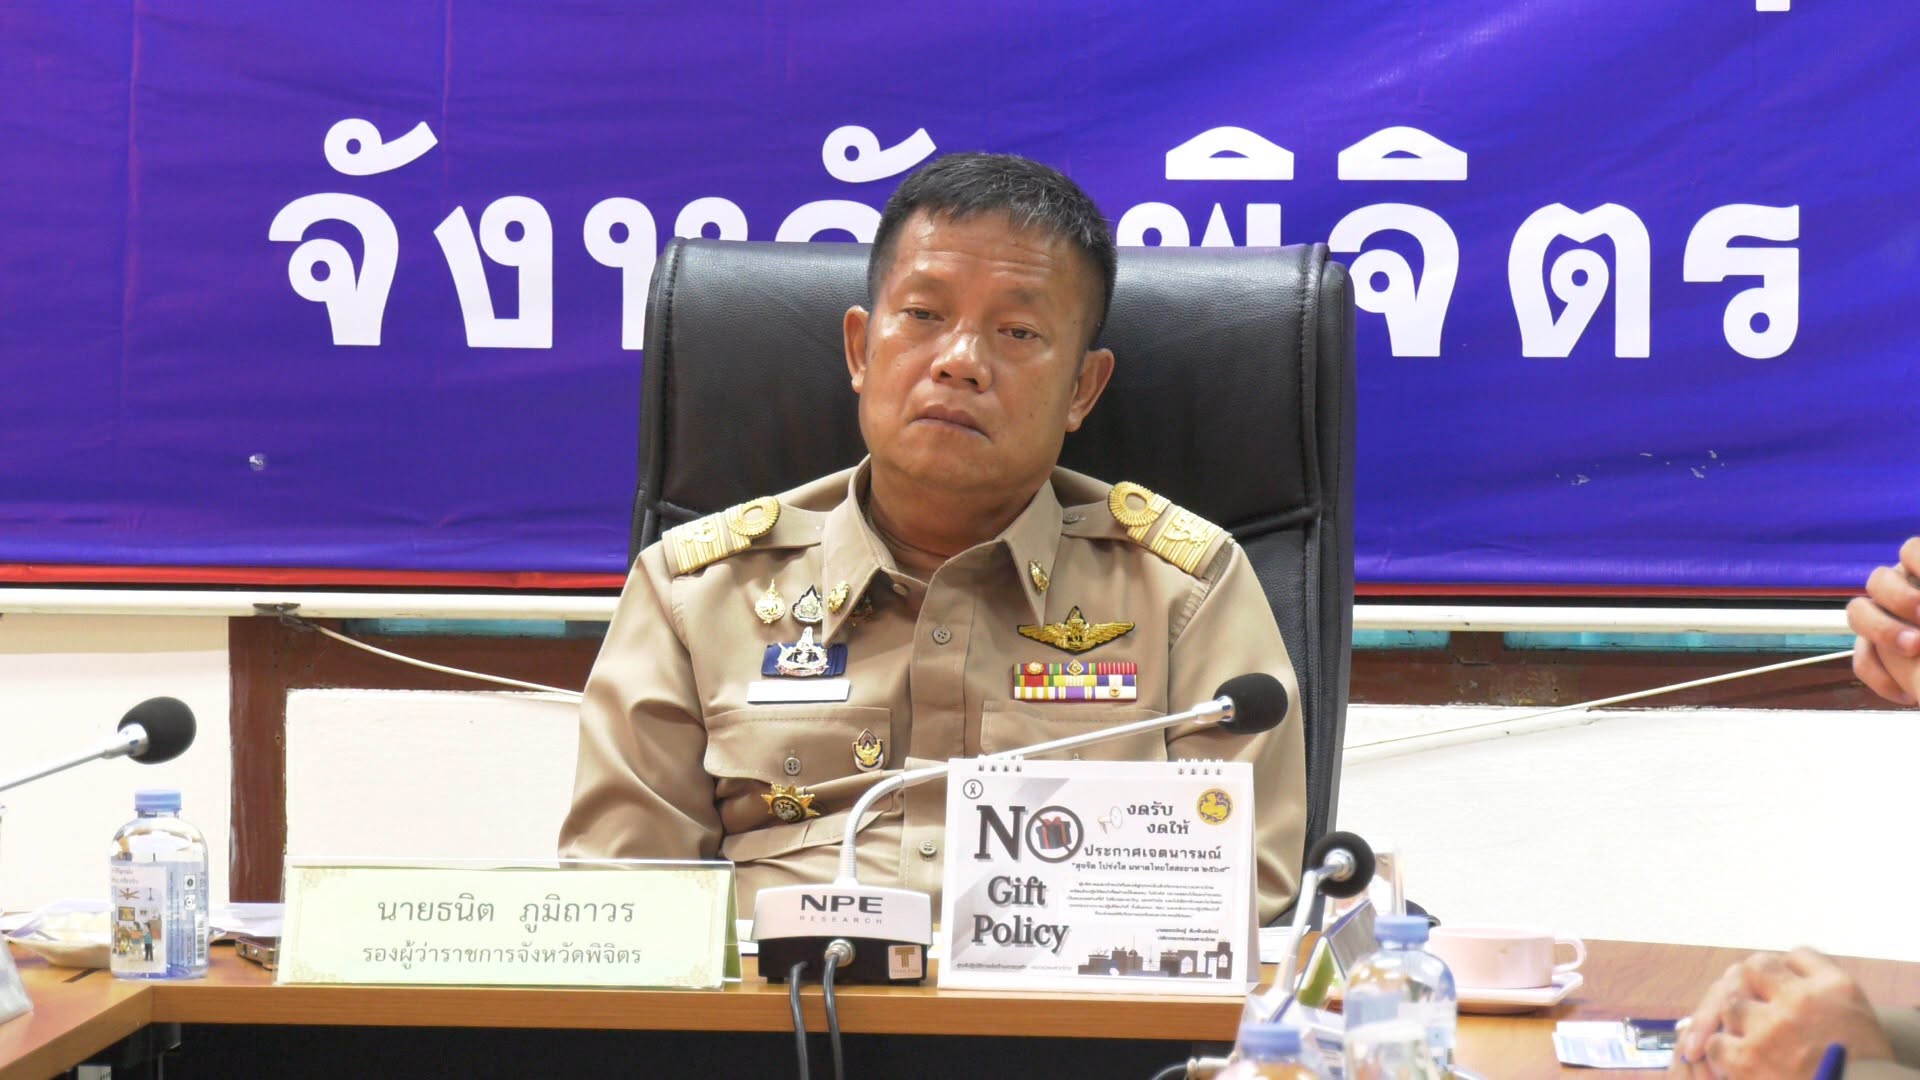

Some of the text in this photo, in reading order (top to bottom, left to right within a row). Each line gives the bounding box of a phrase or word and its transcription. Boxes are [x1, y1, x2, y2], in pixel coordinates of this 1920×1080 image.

[1126, 800, 1174, 817] งดรับ
[1146, 819, 1191, 835] งดให้
[1084, 844, 1222, 861] ประกาศเจตนารมณ์
[987, 875, 1047, 906] Gift
[377, 892, 635, 934] นายธนิต ภูมิถาวร
[801, 894, 884, 914] NPE
[799, 915, 882, 925] RESEARCH
[971, 914, 1069, 954] Policy
[363, 940, 642, 970] รองผู้ว่าราชการจังหวัดพิจิตร
